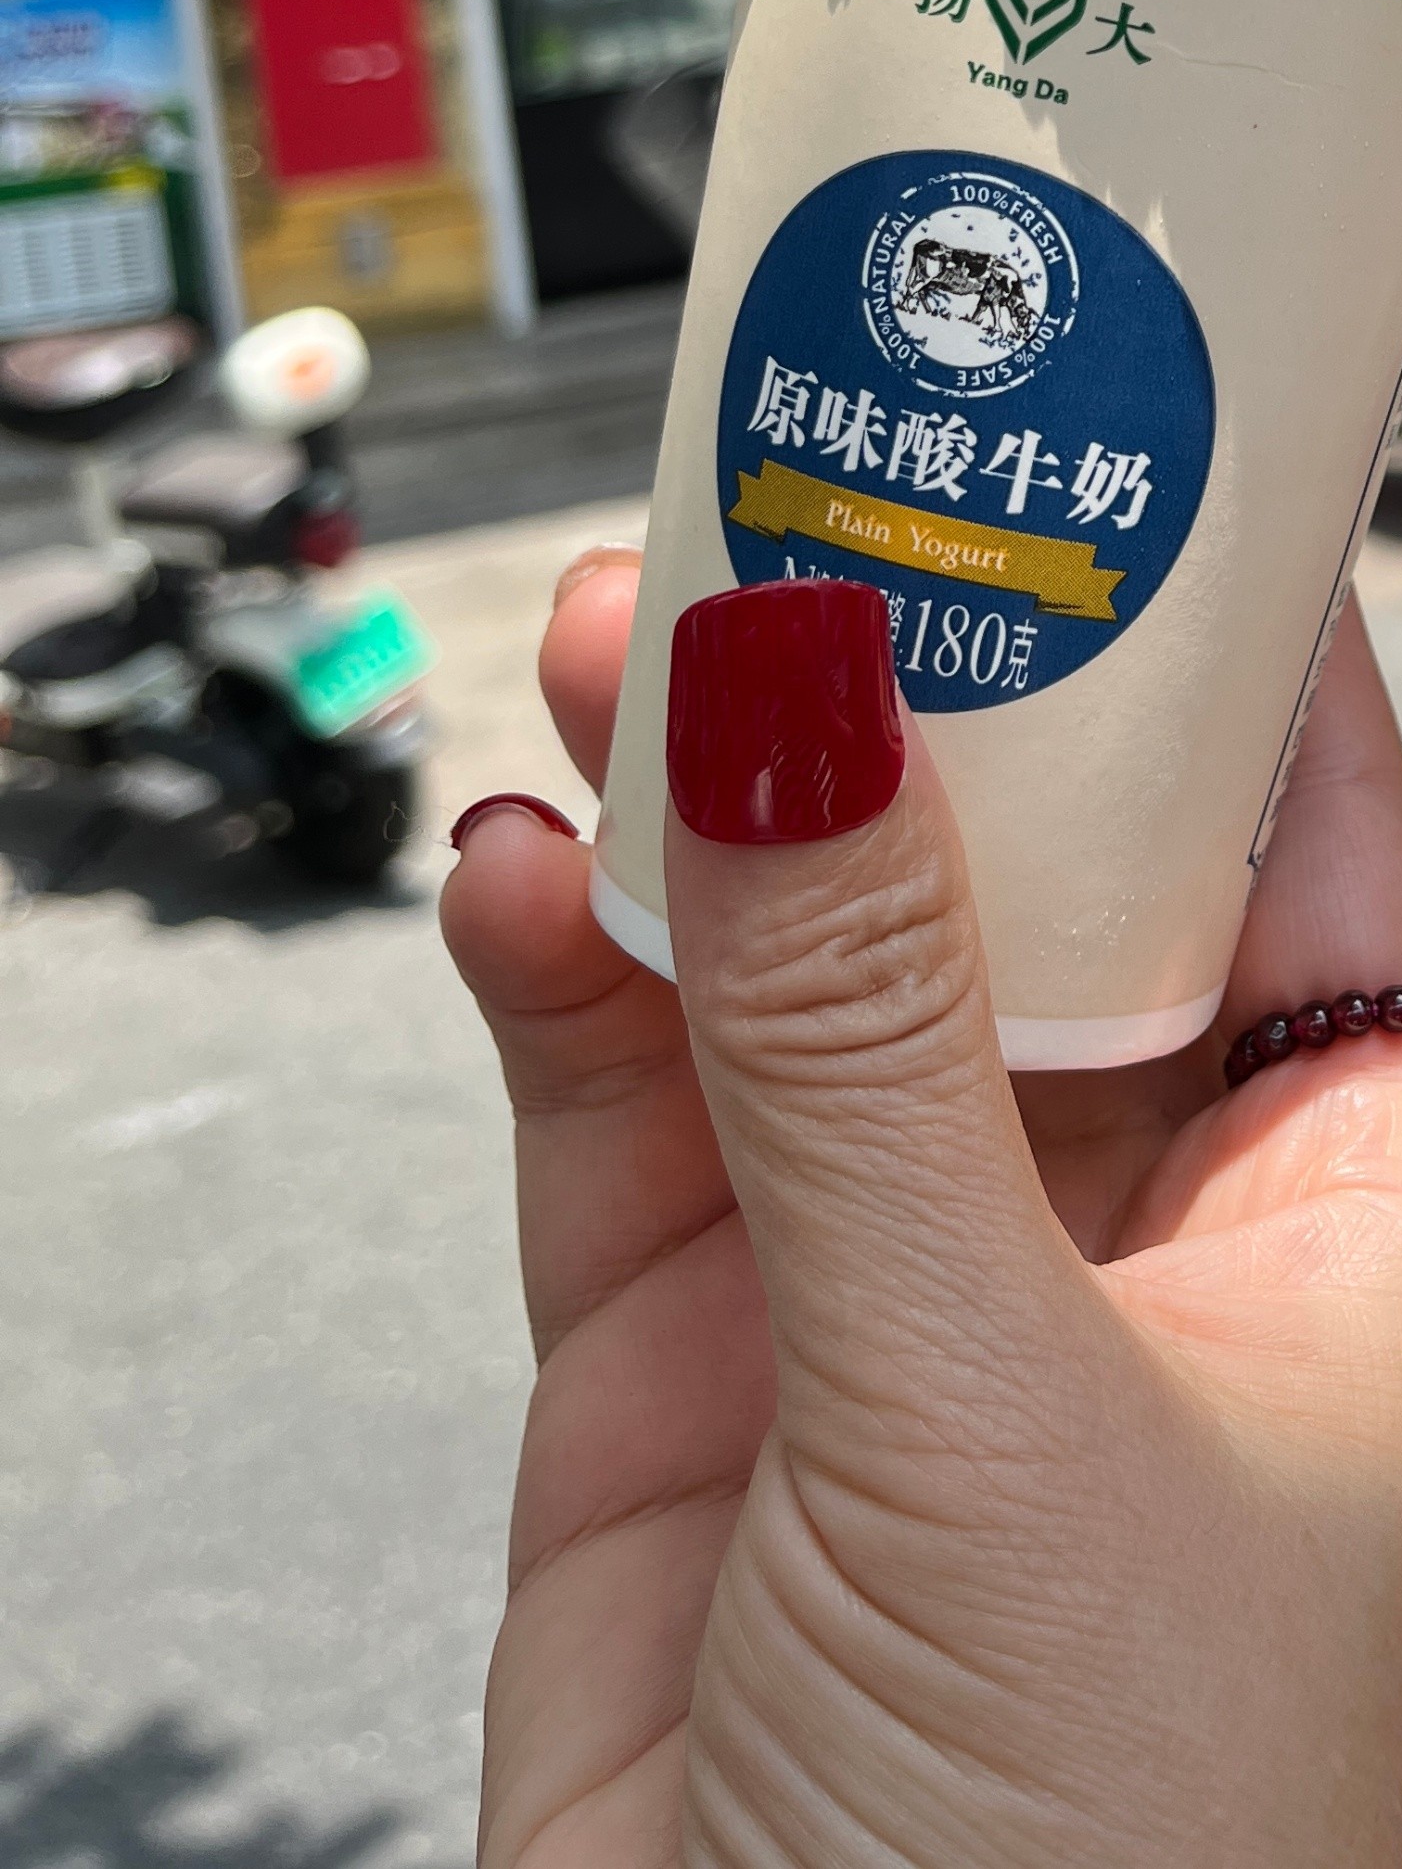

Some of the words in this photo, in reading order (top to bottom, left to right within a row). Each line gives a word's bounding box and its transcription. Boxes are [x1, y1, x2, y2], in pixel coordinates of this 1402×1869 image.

[1085, 2, 1158, 66] 大
[965, 58, 1030, 101] Yang
[1035, 78, 1070, 107] Da
[746, 355, 1158, 530] 原味酸牛奶
[823, 499, 892, 546] Plain
[909, 526, 1010, 573] Yogurt
[905, 599, 1039, 690] 180克
